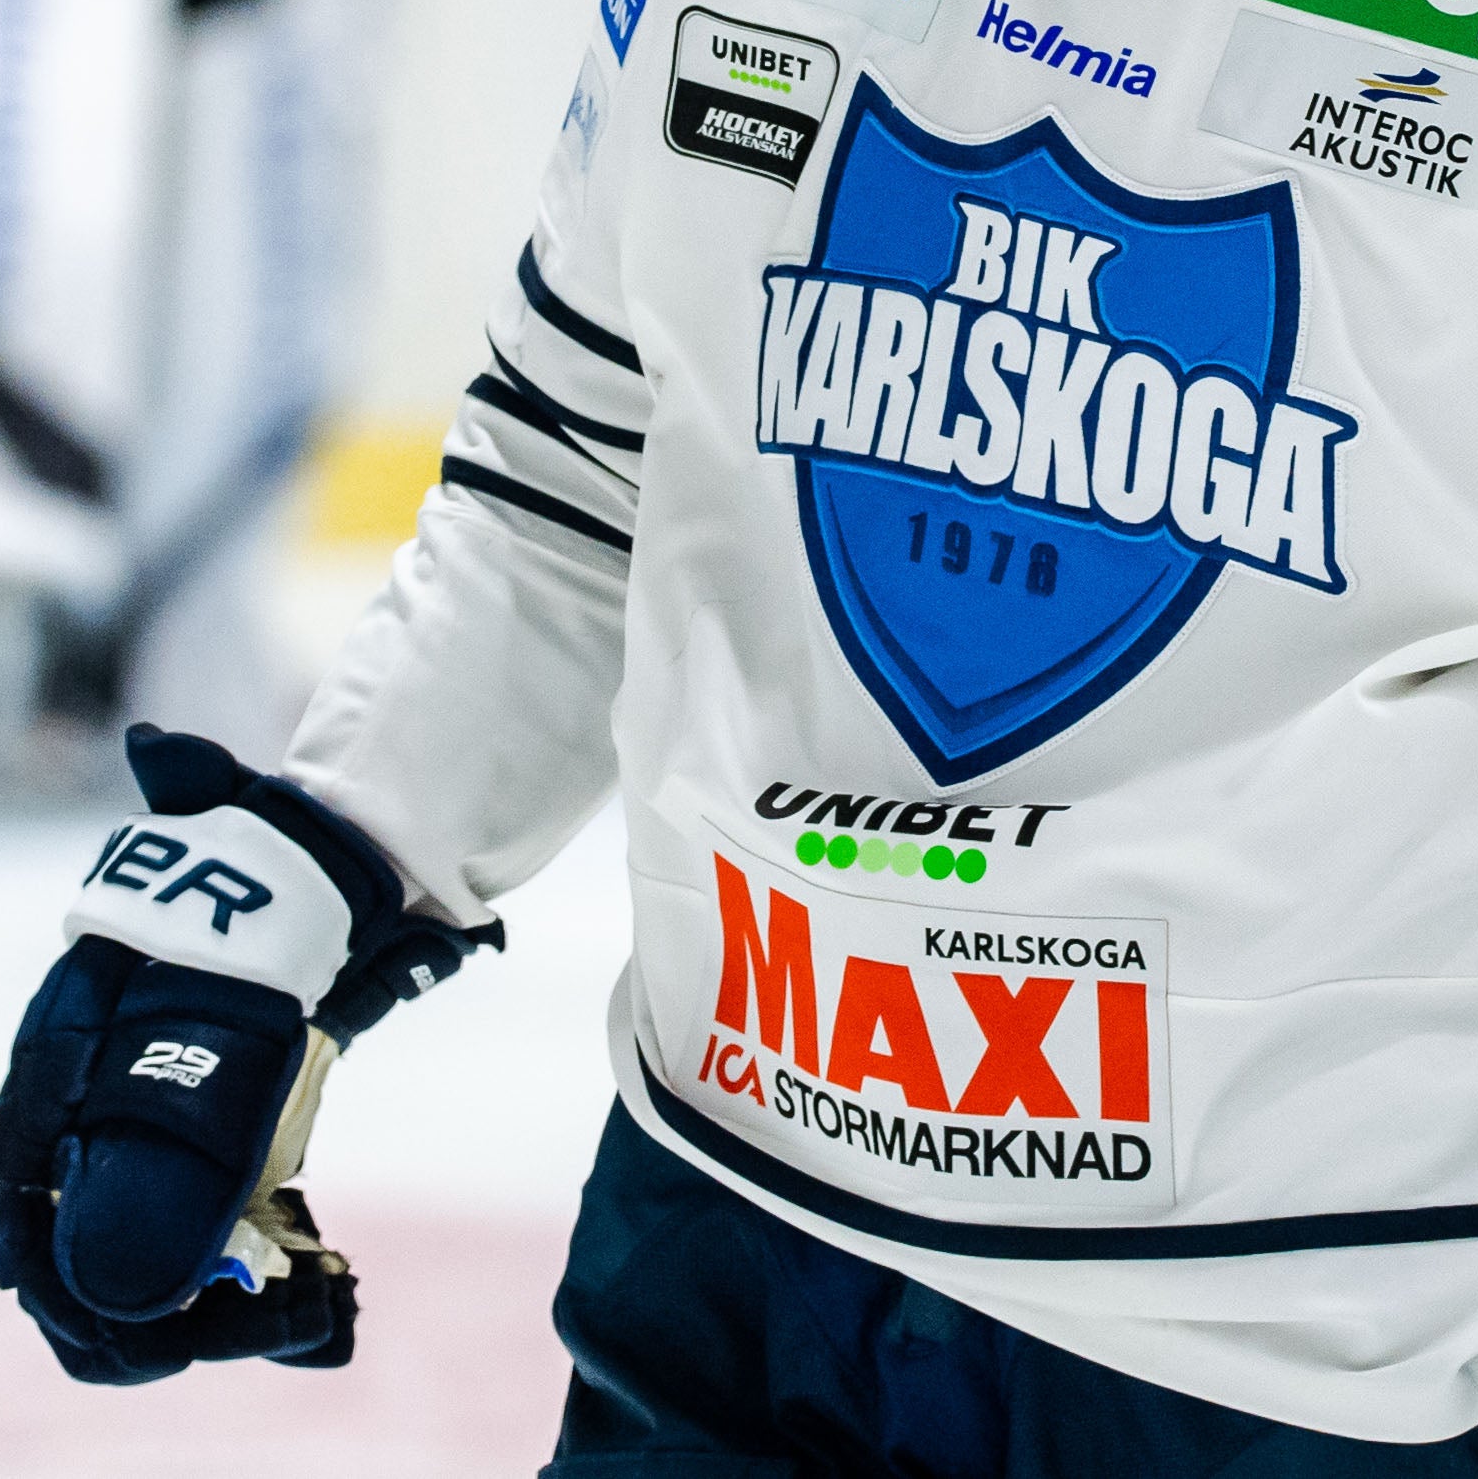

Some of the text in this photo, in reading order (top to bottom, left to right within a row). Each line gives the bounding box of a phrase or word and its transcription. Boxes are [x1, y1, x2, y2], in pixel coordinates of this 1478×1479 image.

[711, 34, 812, 81] UNIBET
[695, 124, 797, 162] ALLSVENSKAN
[703, 106, 805, 150] HOCKEY
[1289, 128, 1461, 200] AKUSTIK
[1303, 92, 1474, 164] INTEROC
[945, 201, 1117, 335] BIK
[761, 274, 1346, 585] KARLSKOGA
[905, 510, 1059, 597] 1978
[754, 781, 1072, 847] UNIBET
[924, 927, 1147, 970] KARLSKOGA
[712, 849, 1150, 1124] MAXI
[129, 1042, 220, 1078] 29
[697, 1033, 1153, 1182] ICA STORMARKNAD
